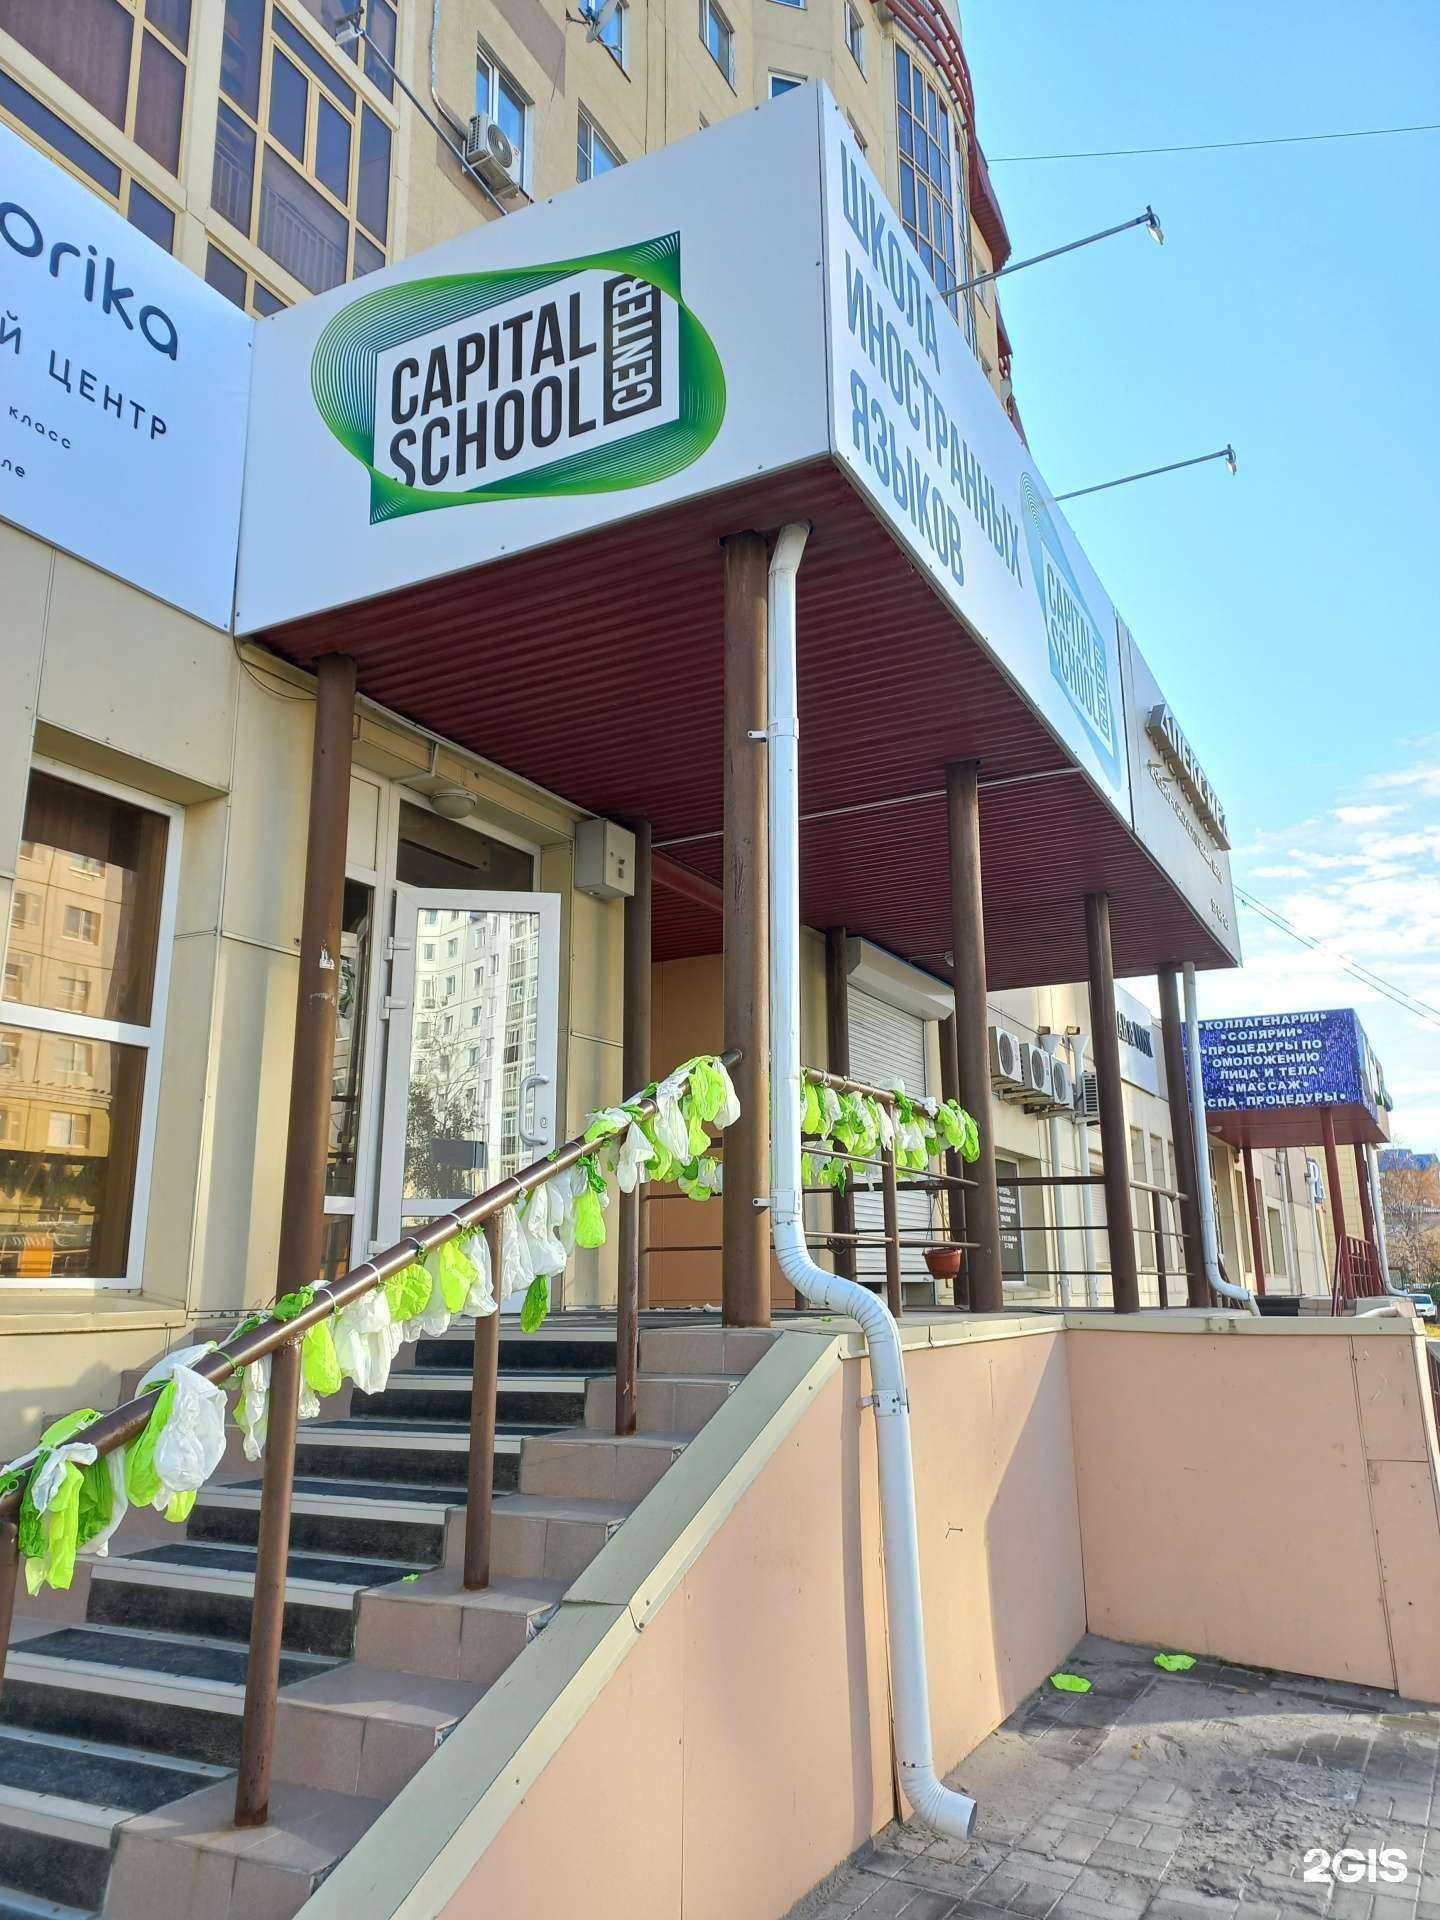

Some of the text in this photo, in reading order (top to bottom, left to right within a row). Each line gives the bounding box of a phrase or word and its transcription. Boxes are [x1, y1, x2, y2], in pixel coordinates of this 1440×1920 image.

[840, 140, 941, 376] ШКОЛА
[391, 291, 597, 425] CAPITAL
[612, 277, 653, 412] CENTER
[9, 405, 72, 450] класс
[48, 349, 167, 440] ЦЕНТР
[389, 366, 597, 487] SCHOOL
[844, 249, 1023, 588] ИНОСТРАННЫХ
[850, 368, 965, 587] ЯЗЫКОВ
[1047, 563, 1095, 672] CAPITAL
[1051, 617, 1099, 726] SCHOOL
[1205, 1013, 1320, 1030] КОЛЛАГЕНАРИИ
[1208, 1039, 1322, 1055] ПРОЦЕДУРЫ ПО
[1212, 1052, 1320, 1067] ОМОЛОЖЕНИЮ
[1228, 1028, 1296, 1040] СОЛЯРИИ
[1207, 1097, 1236, 1108] СПА
[1246, 1091, 1337, 1107] ПРОЦЕДУРЫ
[1220, 1065, 1318, 1079] ЛИЦА И ТЕЛА
[1235, 1080, 1300, 1093] МАССАЖ
